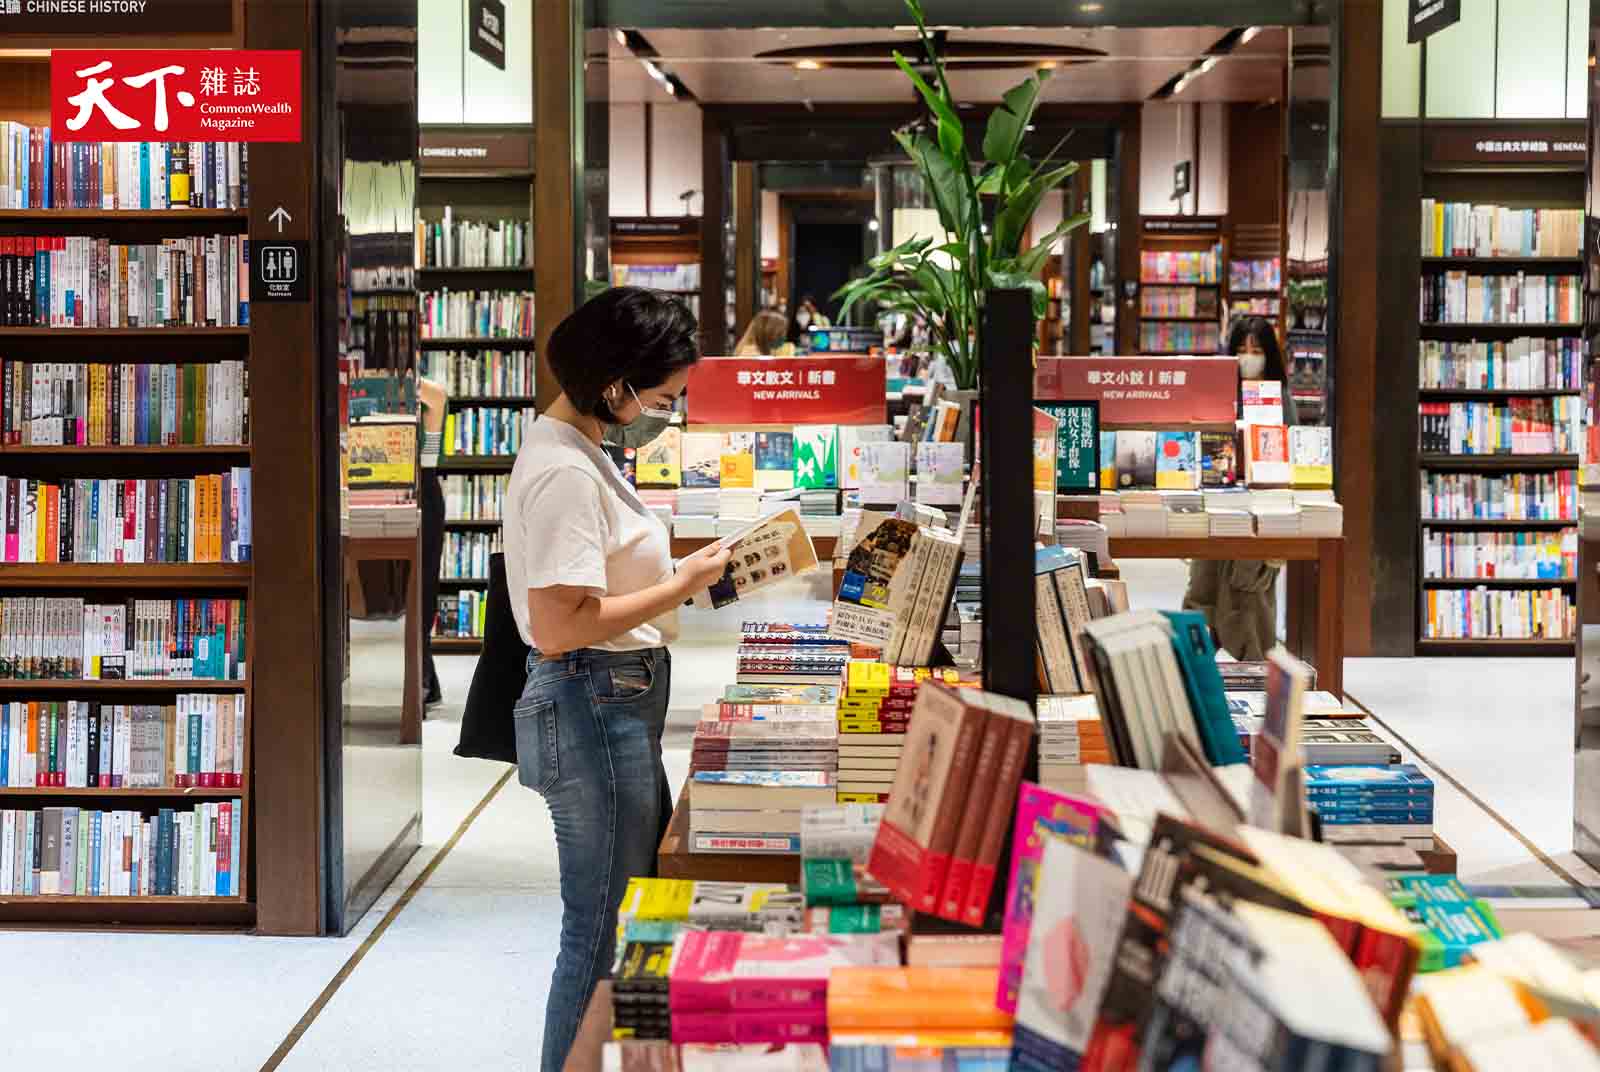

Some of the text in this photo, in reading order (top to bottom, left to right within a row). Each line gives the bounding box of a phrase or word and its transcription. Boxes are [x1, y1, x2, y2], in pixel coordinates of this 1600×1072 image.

[27, 0, 147, 13] CHINESE HISTORY
[753, 390, 820, 400] NEW ARRIVALS
[1103, 390, 1170, 399] NEW ARRIVALS
